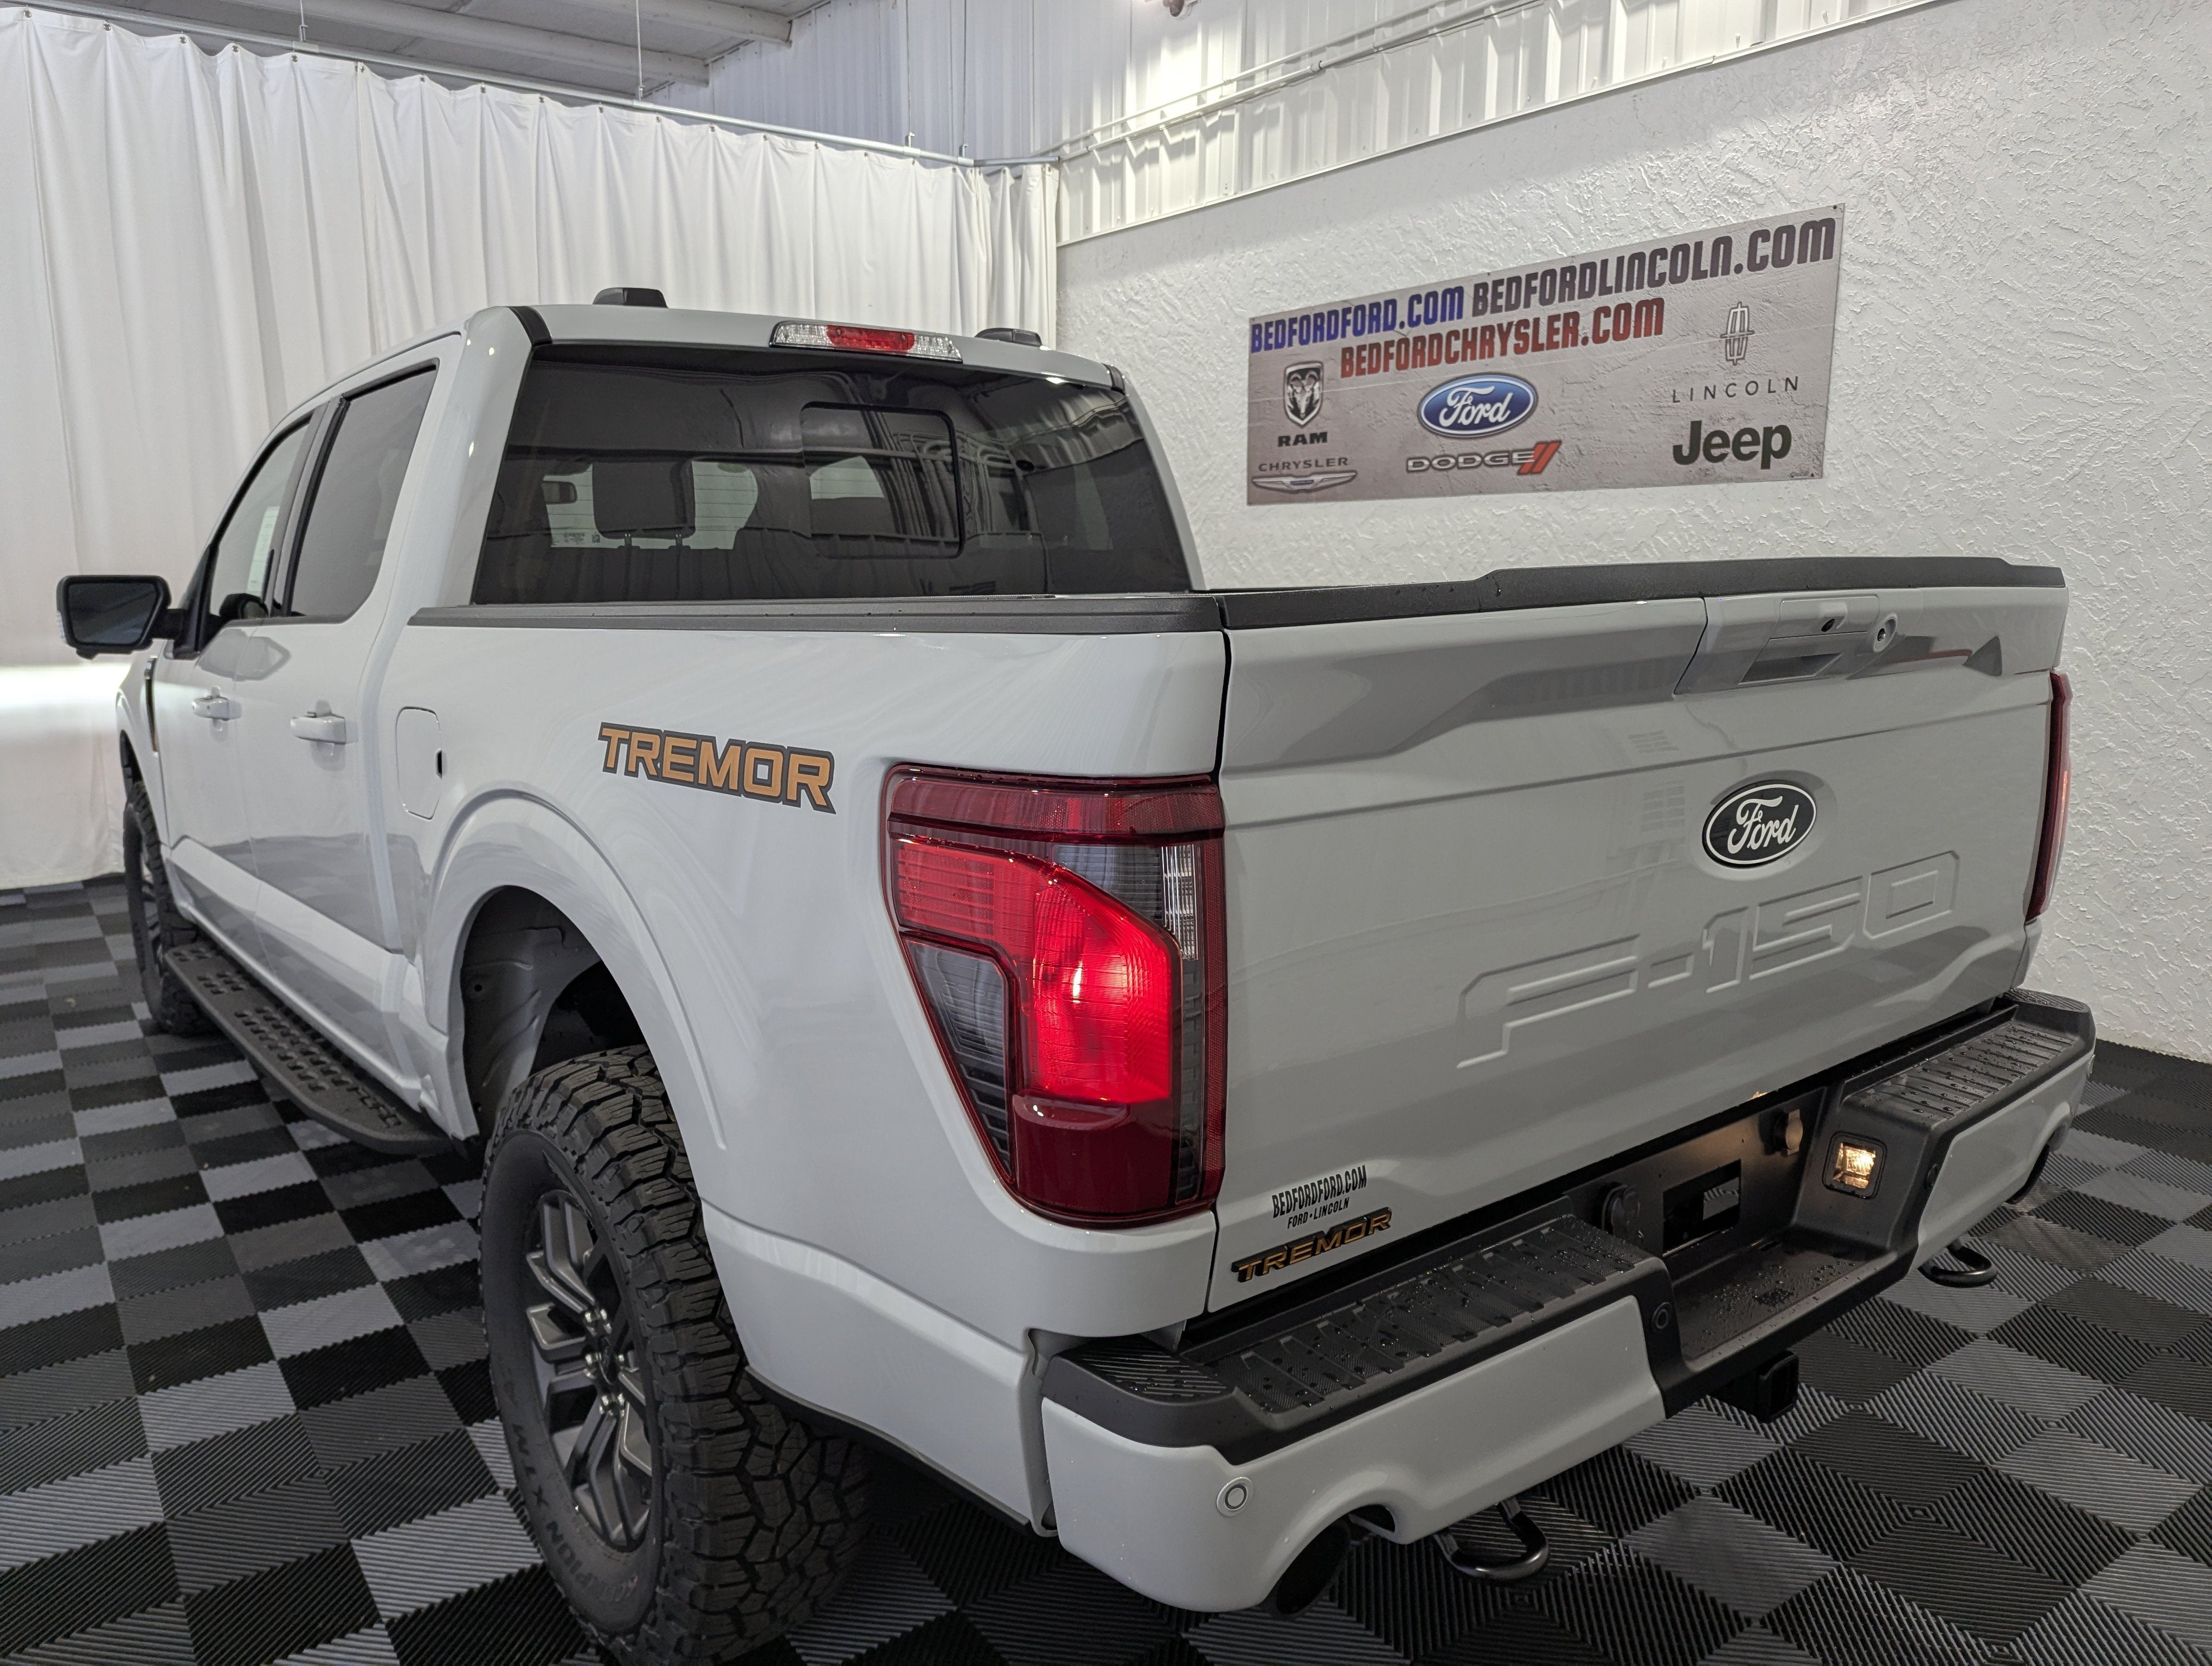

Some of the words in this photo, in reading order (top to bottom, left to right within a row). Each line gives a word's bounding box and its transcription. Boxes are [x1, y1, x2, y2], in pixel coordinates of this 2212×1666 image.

[1251, 286, 1464, 353] BEDFORDFORD.COM
[1472, 217, 1836, 317] BEDFORDLINCOLN.COM
[1341, 297, 1665, 379] BEDFORDCHRYSLER.COM
[1439, 386, 1513, 427] Ford
[1673, 376, 1798, 403] LINCOLN
[1258, 457, 1348, 472] CHRYSLER
[1278, 432, 1328, 447] RAM
[1406, 447, 1535, 473] DODGE
[1673, 420, 1792, 470] Jeep
[598, 722, 836, 814] TREMOR
[1727, 796, 1799, 854] Ford
[1457, 850, 1959, 1068] F-150
[1272, 1165, 1367, 1218] BEDFORDFORD.COM
[1231, 1207, 1392, 1283] TREMOR
